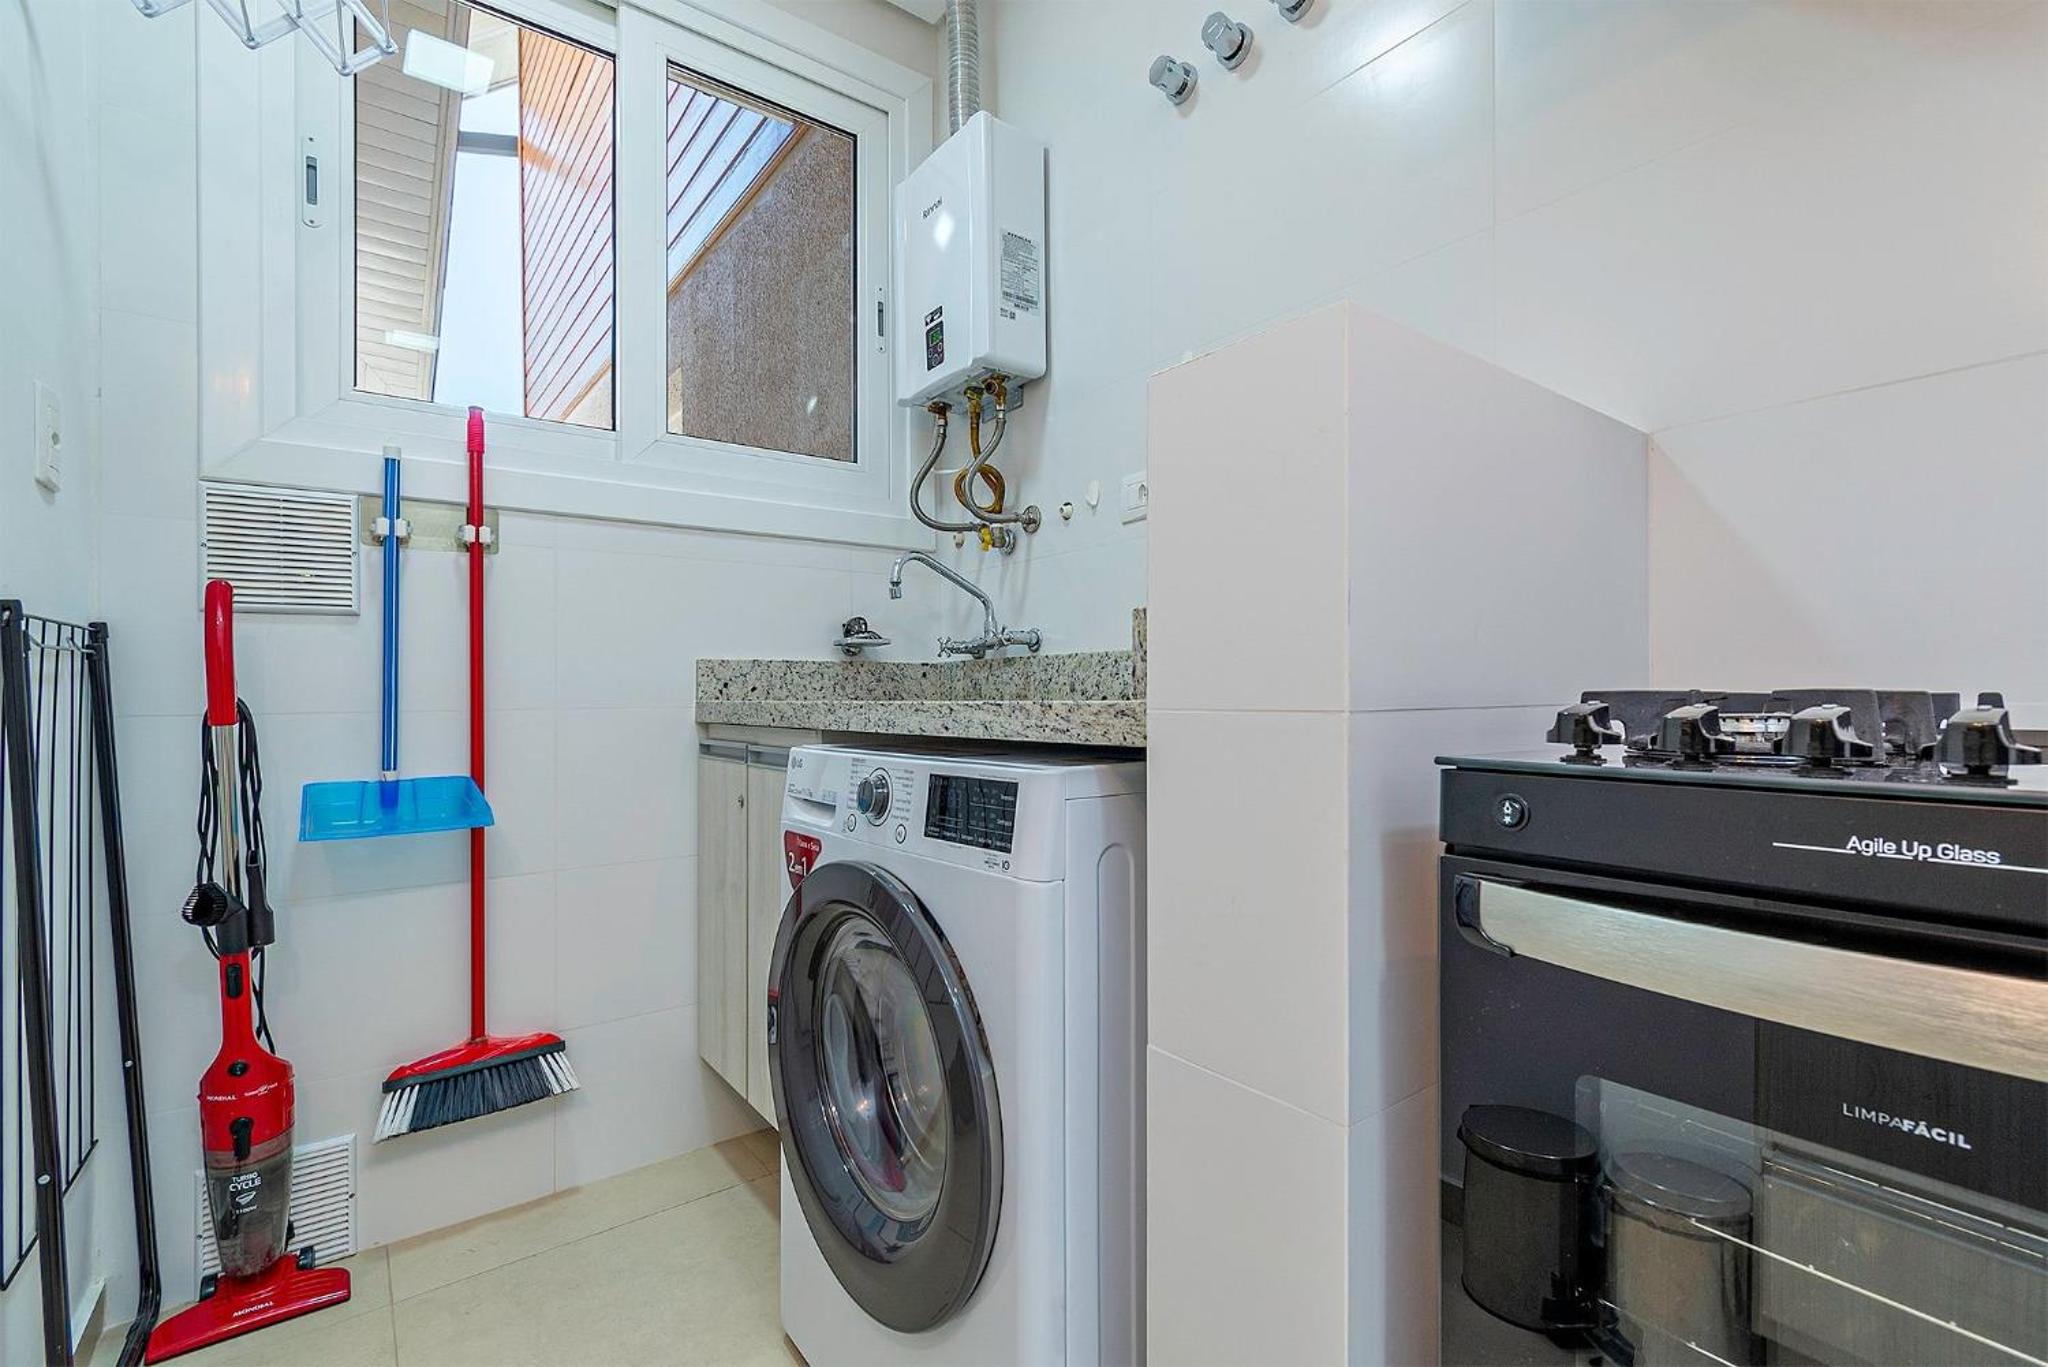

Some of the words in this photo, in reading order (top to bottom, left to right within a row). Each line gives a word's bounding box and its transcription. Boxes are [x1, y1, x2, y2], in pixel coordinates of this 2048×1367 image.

[1846, 835, 1897, 856] Agile
[1901, 840, 1932, 861] Up
[1936, 843, 2001, 864] Glass
[1843, 1102, 1972, 1150] LIMPAFÁCIL
[229, 1176, 261, 1191] CYCLE
[232, 1171, 258, 1183] TURBO
[232, 1300, 274, 1318] MONDIAL
